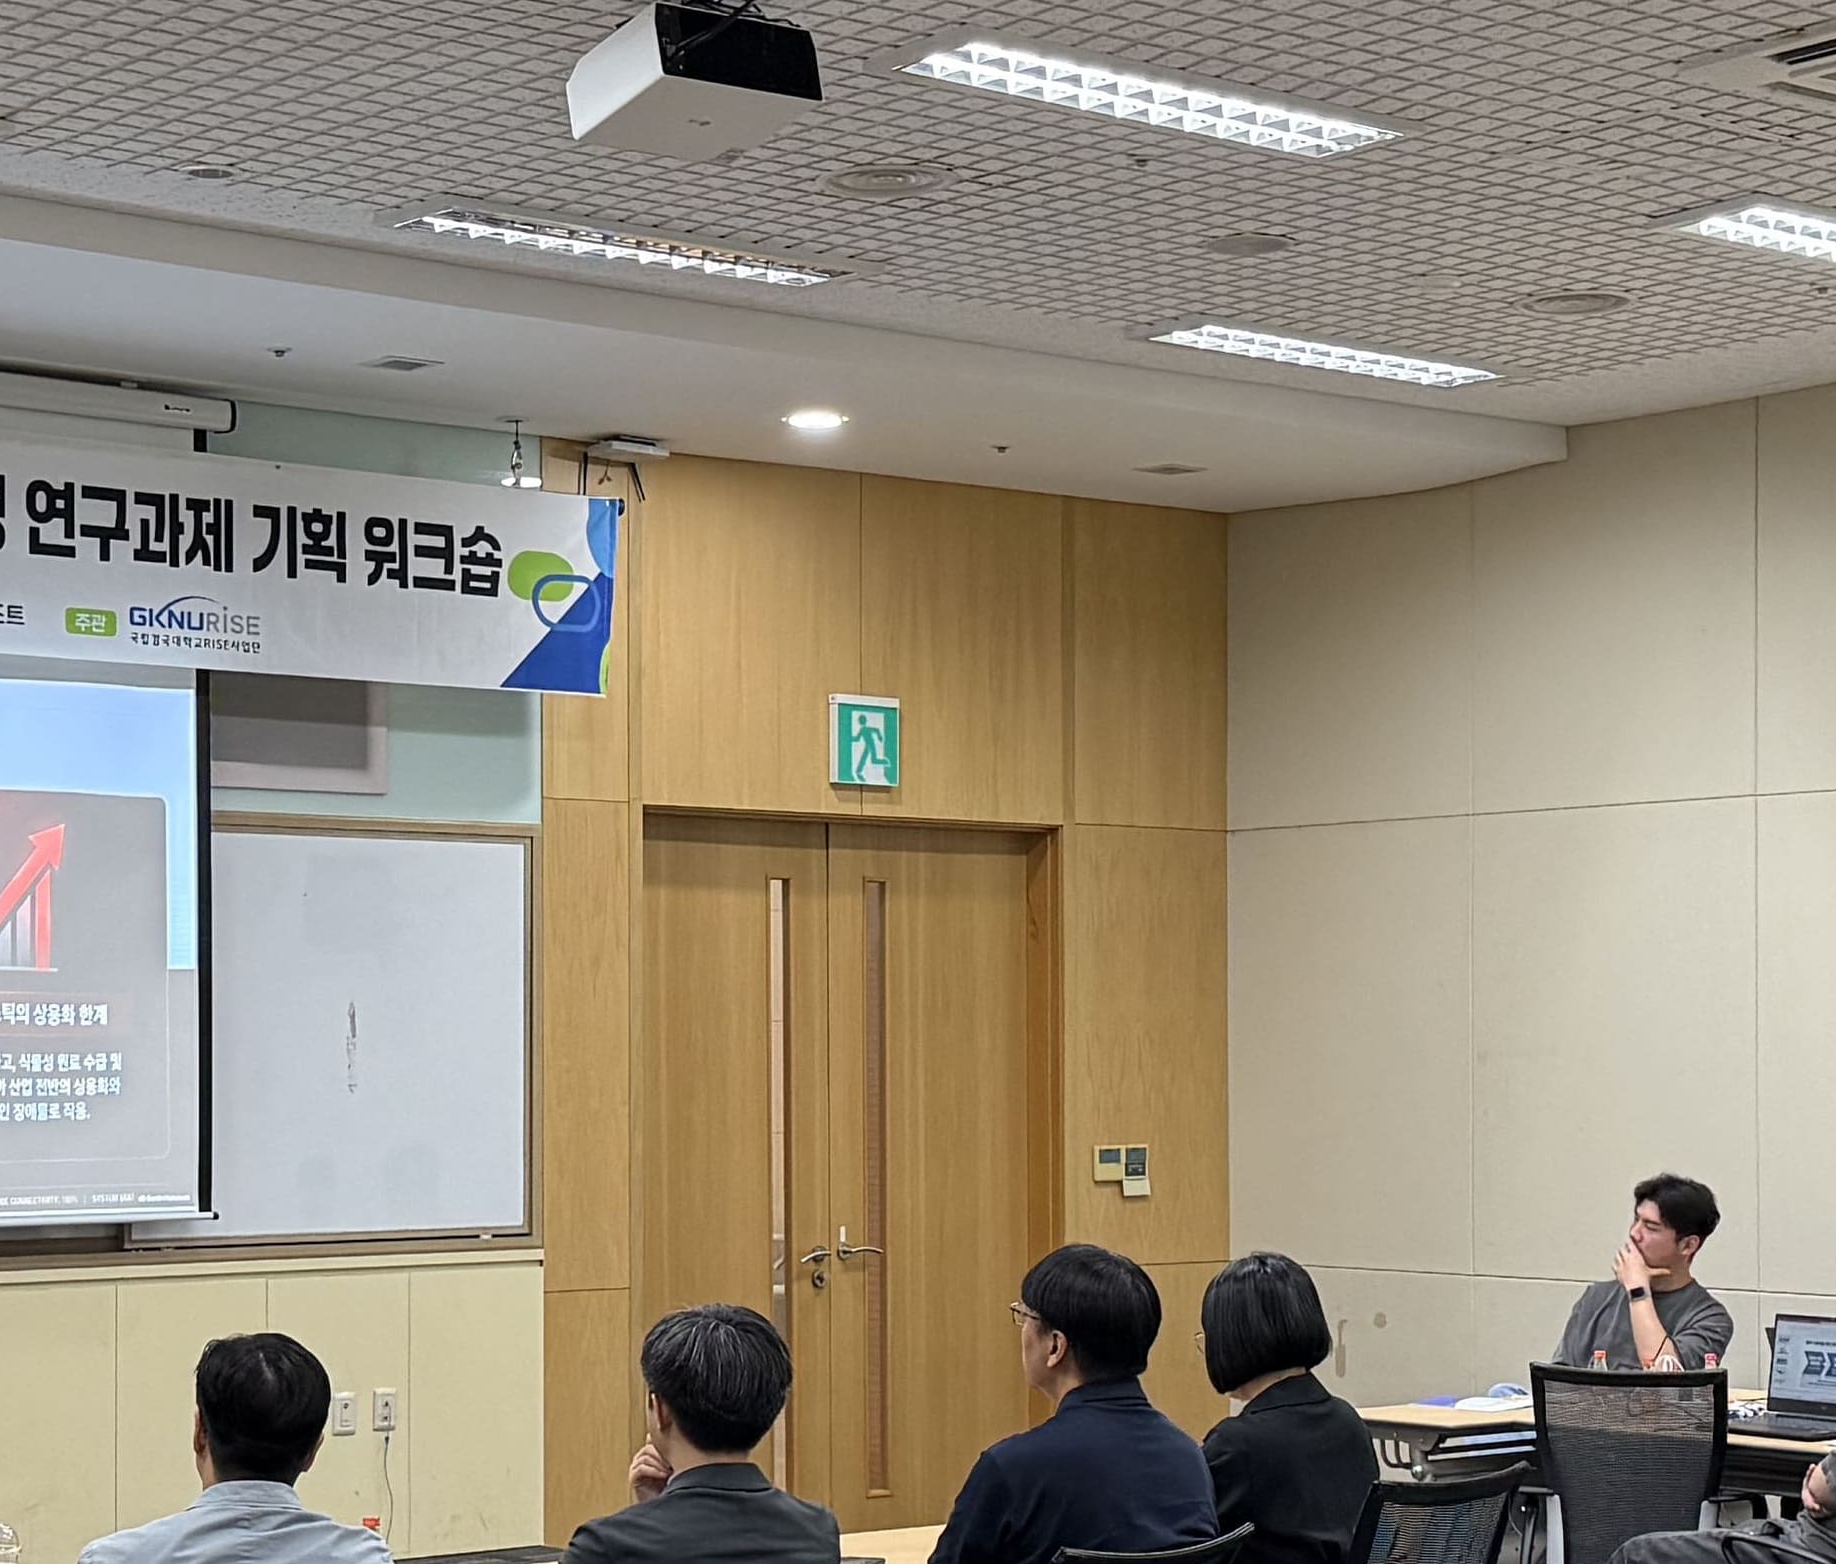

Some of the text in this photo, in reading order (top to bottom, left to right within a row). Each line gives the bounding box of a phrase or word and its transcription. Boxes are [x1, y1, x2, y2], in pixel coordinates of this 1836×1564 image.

[25, 478, 235, 577] 연구과제
[251, 503, 351, 589] 기획
[362, 516, 504, 598] 워크숍
[74, 612, 107, 632] 주관
[33, 1003, 75, 1026] 상용화
[78, 1003, 108, 1026] 한계
